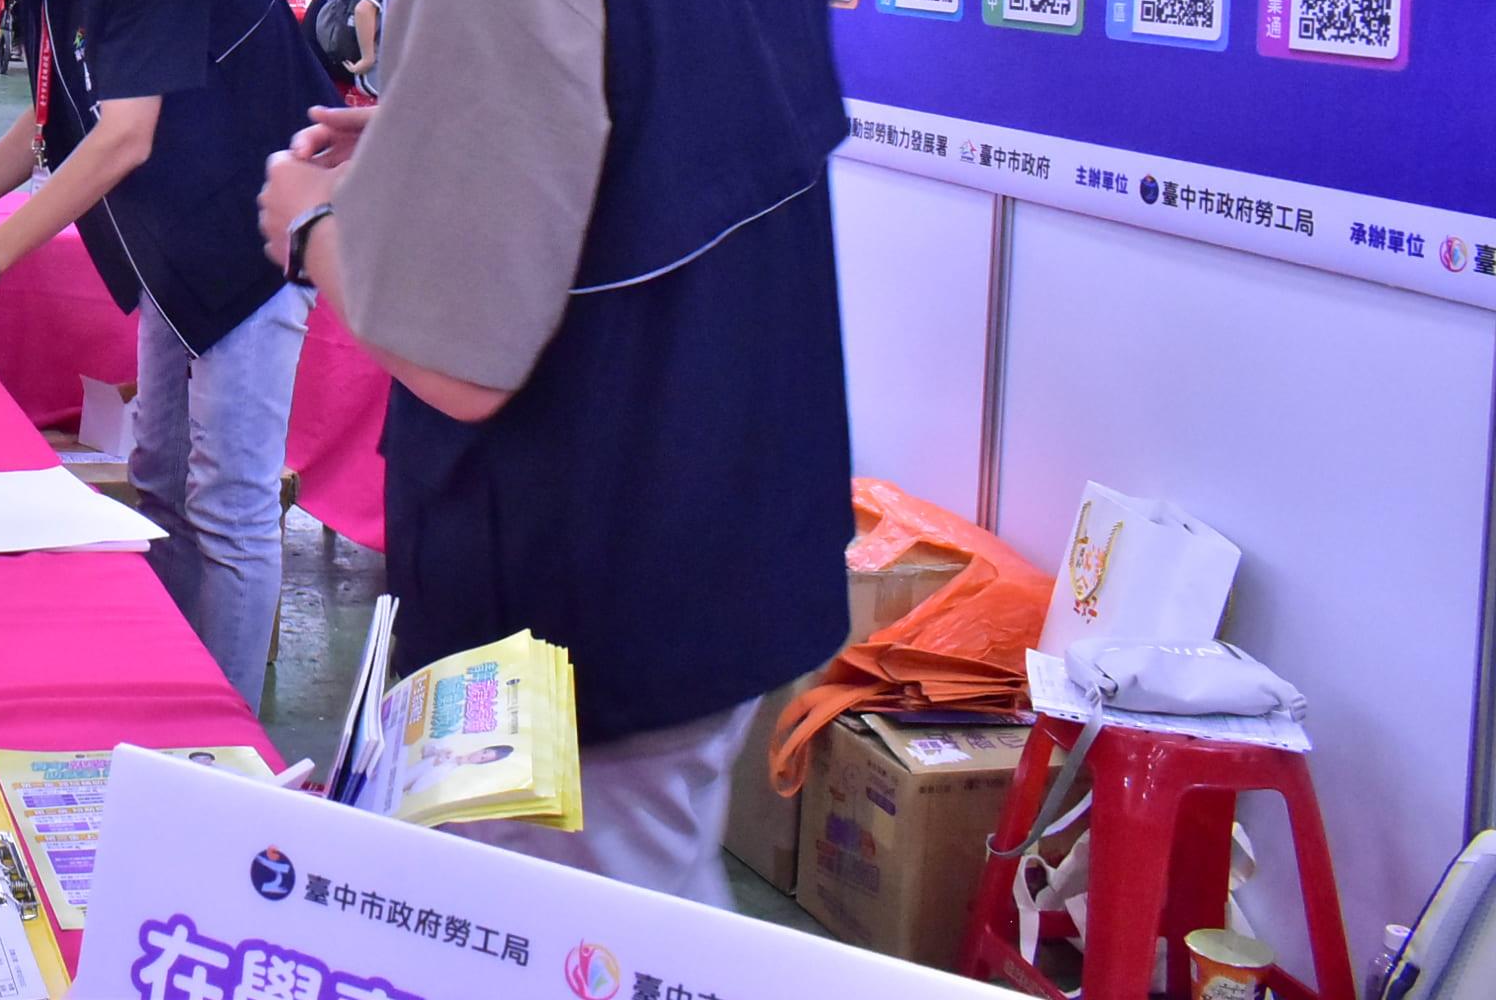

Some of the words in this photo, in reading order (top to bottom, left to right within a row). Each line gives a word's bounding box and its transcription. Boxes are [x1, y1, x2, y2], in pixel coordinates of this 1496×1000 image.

[978, 142, 1051, 180] 臺中市政府
[1075, 165, 1129, 194] 主辦單位
[1162, 180, 1314, 237] 臺中市政府勞工局
[1350, 222, 1425, 259] 承辦單位
[304, 873, 529, 967] 臺中市政府勞工局
[632, 972, 726, 1000] 臺中
